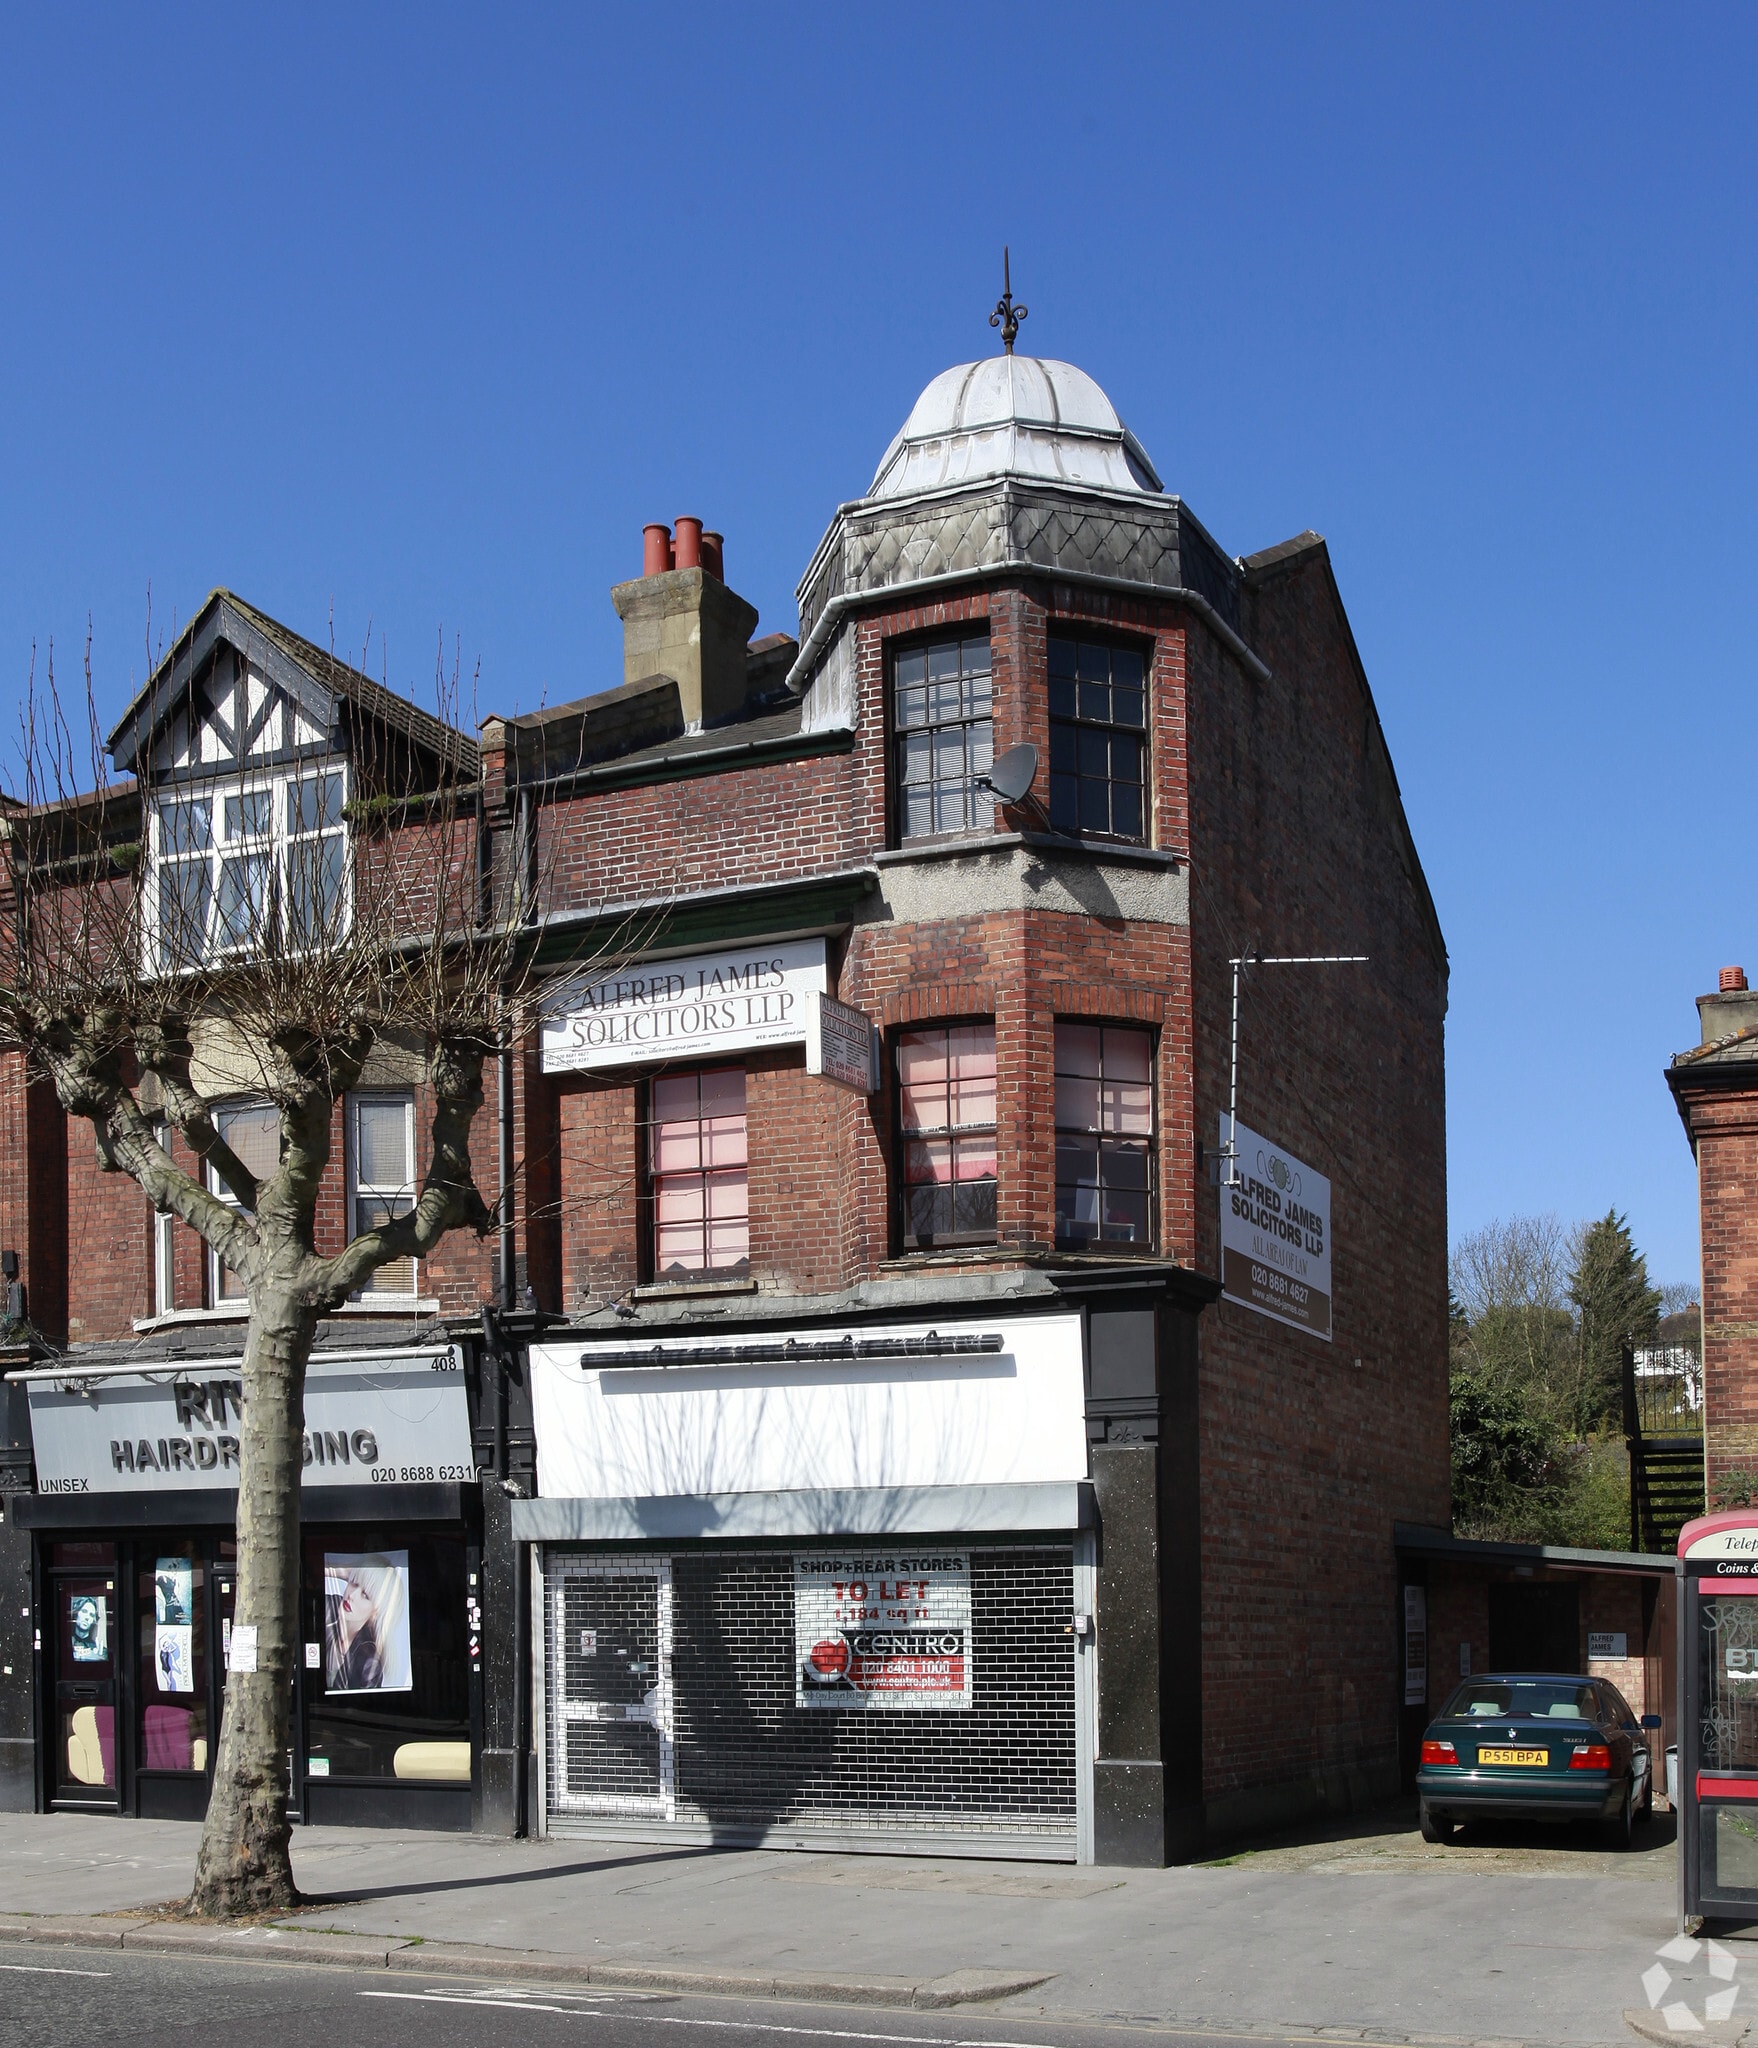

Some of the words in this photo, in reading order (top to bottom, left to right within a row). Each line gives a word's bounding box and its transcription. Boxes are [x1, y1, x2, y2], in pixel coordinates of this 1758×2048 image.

[580, 974, 685, 1012] ALFRED
[694, 958, 785, 1003] JAMES
[572, 1000, 736, 1048] SOLICITORS
[745, 992, 794, 1025] LLP
[1230, 1168, 1281, 1213] ALFRED
[1284, 1199, 1323, 1238] JAMES
[1231, 1193, 1302, 1249] SOLICITORS
[1304, 1233, 1323, 1258] LLP
[1251, 1234, 1265, 1258] ALL
[1265, 1241, 1285, 1267] AREAS
[1286, 1250, 1295, 1271] OF
[1295, 1255, 1309, 1276] LAW
[1251, 1264, 1268, 1287] 020
[1268, 1272, 1288, 1296] 8681
[1289, 1282, 1309, 1305] 4627
[431, 1357, 457, 1372] 408
[371, 1467, 396, 1483] 020
[401, 1466, 434, 1481] 8688
[439, 1465, 472, 1480] 6231
[40, 1478, 90, 1493] UNISEX
[900, 1557, 963, 1572] STORES
[1716, 1562, 1749, 1574] Coins
[1750, 1562, 1758, 1574] &
[831, 1580, 868, 1602] TO
[879, 1580, 930, 1601] LET
[834, 1606, 880, 1623] 1,184
[886, 1609, 908, 1624] sq
[914, 1606, 929, 1620] ft
[1590, 1634, 1615, 1642] ALFRED
[1590, 1643, 1612, 1651] JAMES
[861, 1660, 884, 1674] 020
[886, 1660, 915, 1674] 8401
[921, 1660, 950, 1674] 1000
[1517, 1751, 1543, 1763] BPA
